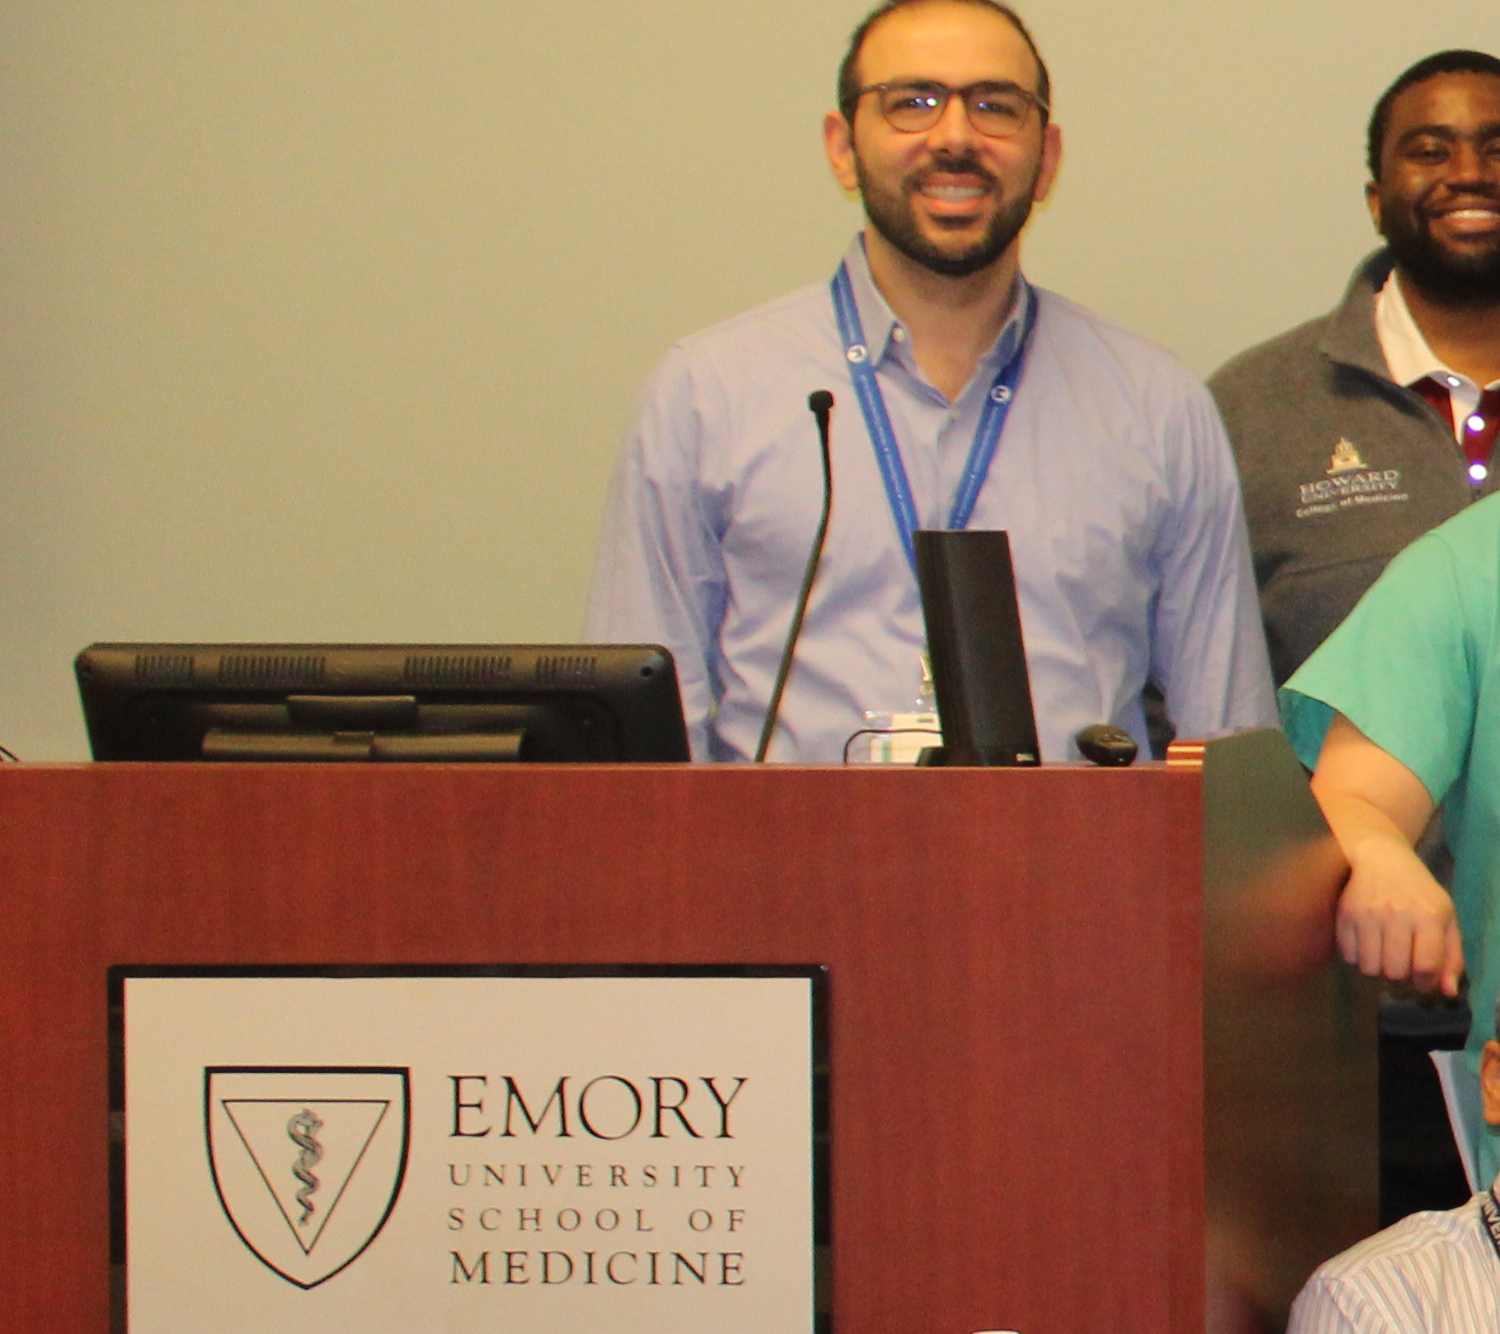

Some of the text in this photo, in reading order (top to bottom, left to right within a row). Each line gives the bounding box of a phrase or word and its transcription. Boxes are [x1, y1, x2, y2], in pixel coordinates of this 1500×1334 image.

[1300, 469, 1400, 496] HOWARD
[1301, 480, 1398, 503] UNIVERSITY
[1340, 496, 1353, 507] of
[447, 1074, 750, 1140] EMORY
[448, 1163, 746, 1188] UNIVERSITY
[447, 1207, 746, 1232] SCHOOL OF
[449, 1250, 746, 1286] MEDICINE
